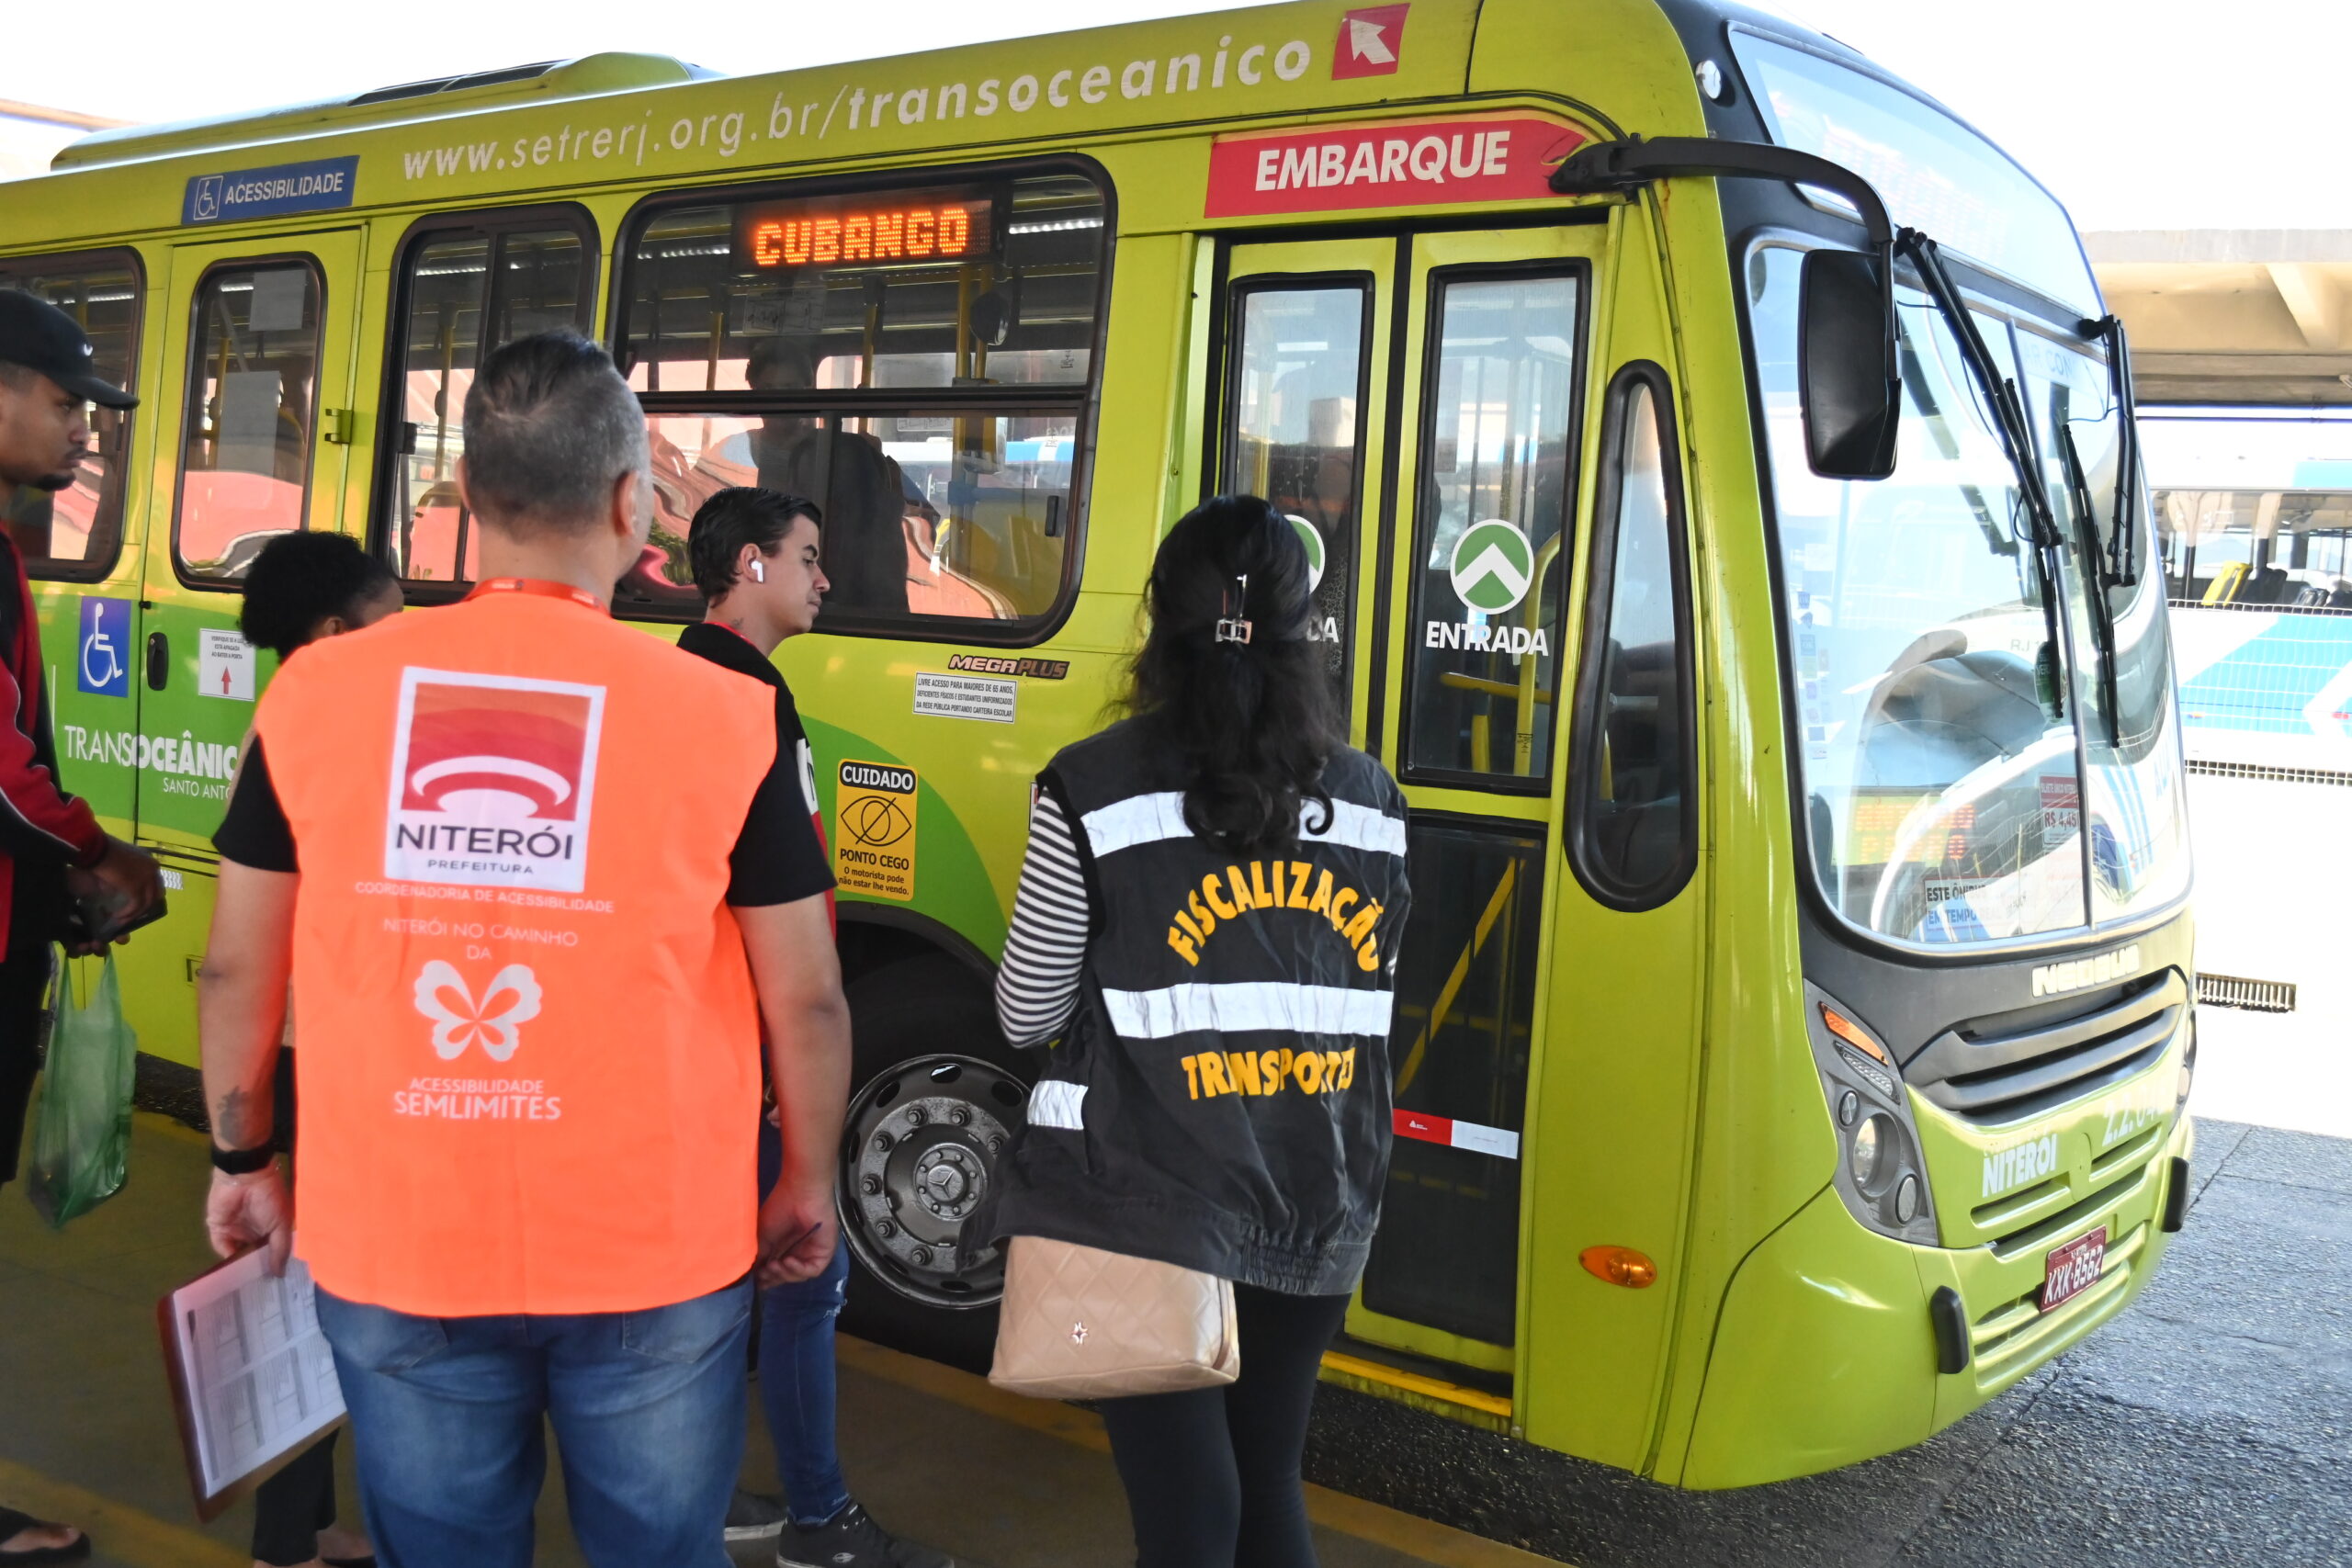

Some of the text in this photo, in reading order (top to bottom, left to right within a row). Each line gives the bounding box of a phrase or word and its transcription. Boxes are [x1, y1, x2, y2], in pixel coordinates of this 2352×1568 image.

[404, 35, 1312, 180] www.setrerj.org.br/transoceanico
[1255, 130, 1510, 191] EMBARQUE
[225, 172, 345, 205] ACESSIBILIDADE
[755, 208, 967, 265] CUBANGO
[1425, 621, 1549, 657] ENTRADA
[917, 690, 940, 698] DEFICIENTES
[957, 694, 981, 703] ESTUDANTES
[982, 695, 1012, 705] UNIFORMIZADOS
[918, 678, 931, 687] LIVRE
[932, 679, 950, 688] ACESSO
[950, 681, 963, 690] PARA
[964, 682, 985, 692] MAIORES
[986, 684, 992, 693] DE
[922, 702, 933, 710] REDE
[951, 705, 973, 714] PORTANDO
[973, 706, 993, 715] CARTEIRA
[993, 708, 1012, 717] ESCOLAR
[64, 725, 238, 782] TRANSOCEÂNIC
[163, 777, 200, 796] SANTO
[842, 764, 913, 791] CUIDADO
[396, 822, 573, 860] NITERÓI
[427, 859, 535, 874] PREFEITURA
[840, 848, 910, 871] PONTO CEGO
[838, 875, 910, 896] não estar lhe vendo.
[843, 866, 905, 884] O motorista pode
[356, 882, 615, 913] COORDENADORIA DE ACESSIBILIDADE
[1927, 886, 1950, 902] ESTE
[1167, 860, 1384, 972] FISCALIZAÇÃO
[383, 917, 579, 947] NITERÓI NO CAMINHO
[466, 945, 492, 961] DA
[409, 1077, 544, 1094] ACESSIBILIDADE
